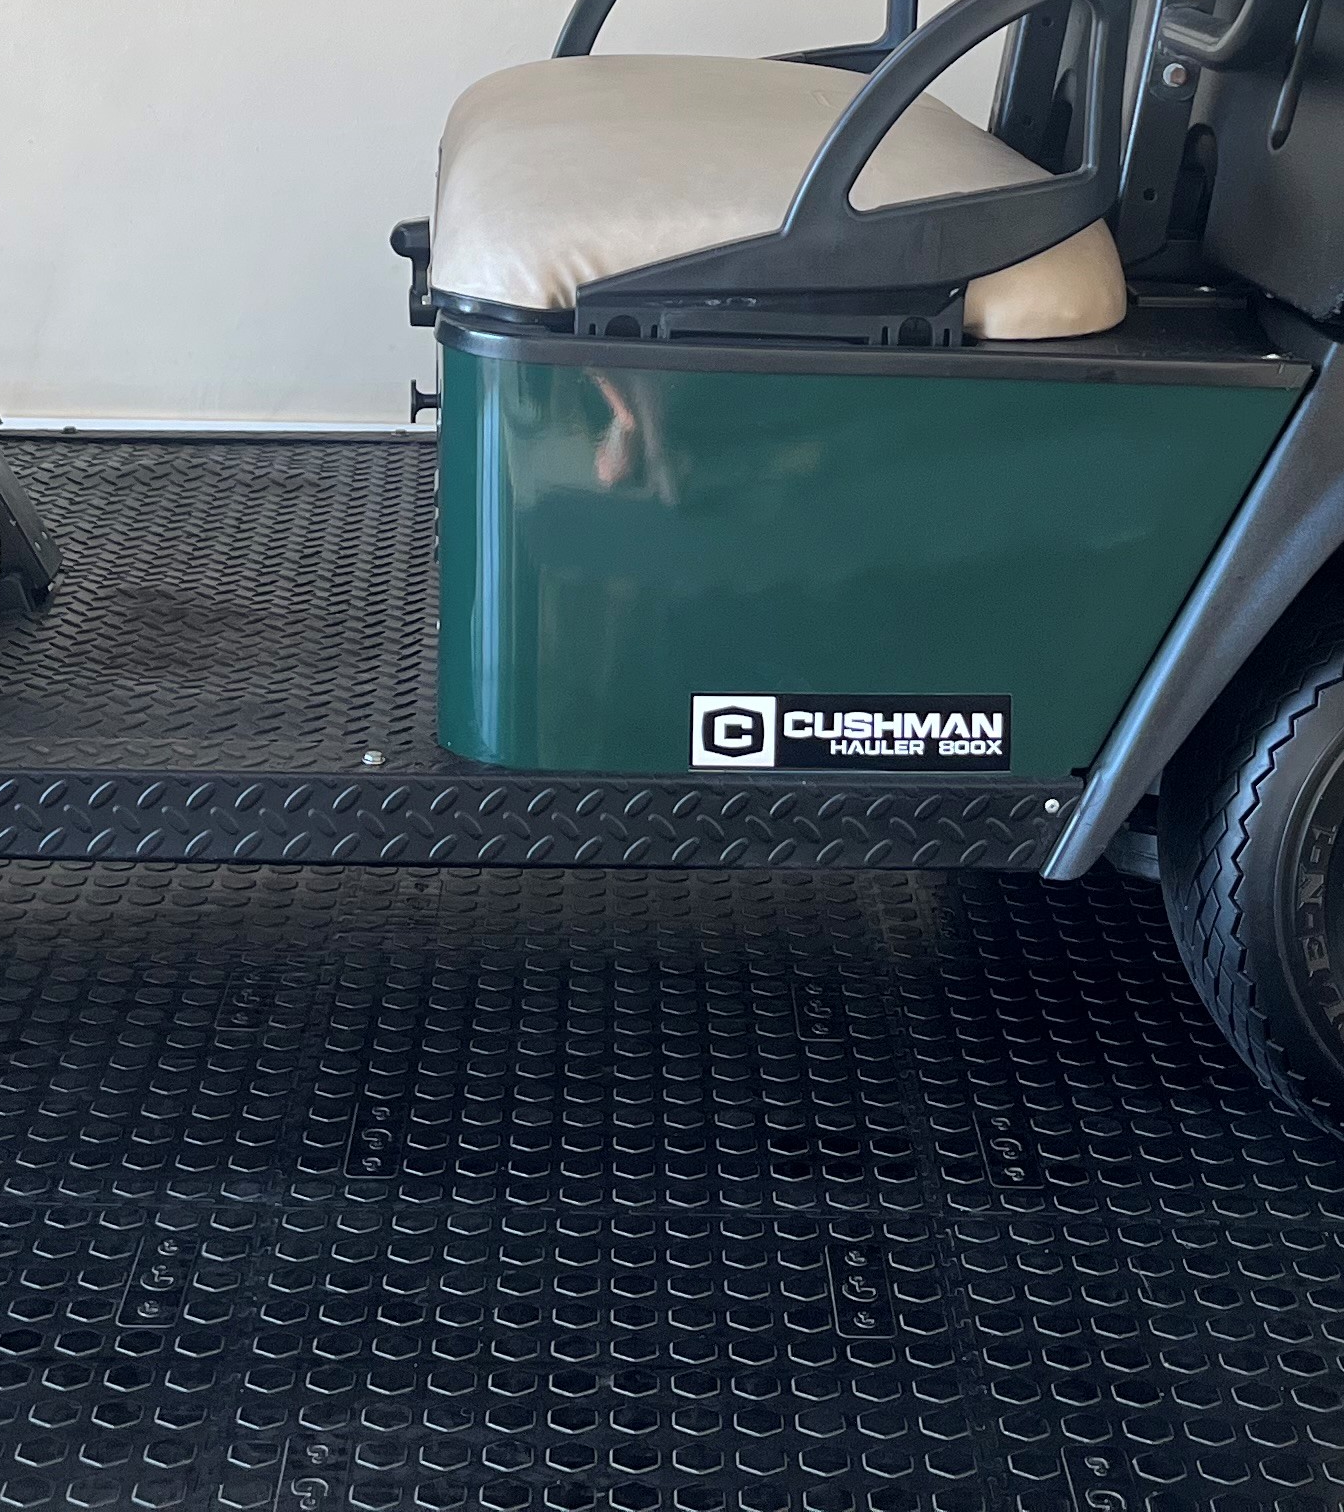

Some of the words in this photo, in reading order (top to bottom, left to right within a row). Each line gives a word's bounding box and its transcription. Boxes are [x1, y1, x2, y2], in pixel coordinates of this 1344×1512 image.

[783, 711, 1003, 738] CUSHMAN
[830, 740, 924, 756] HAULER
[938, 740, 1003, 755] 800X
